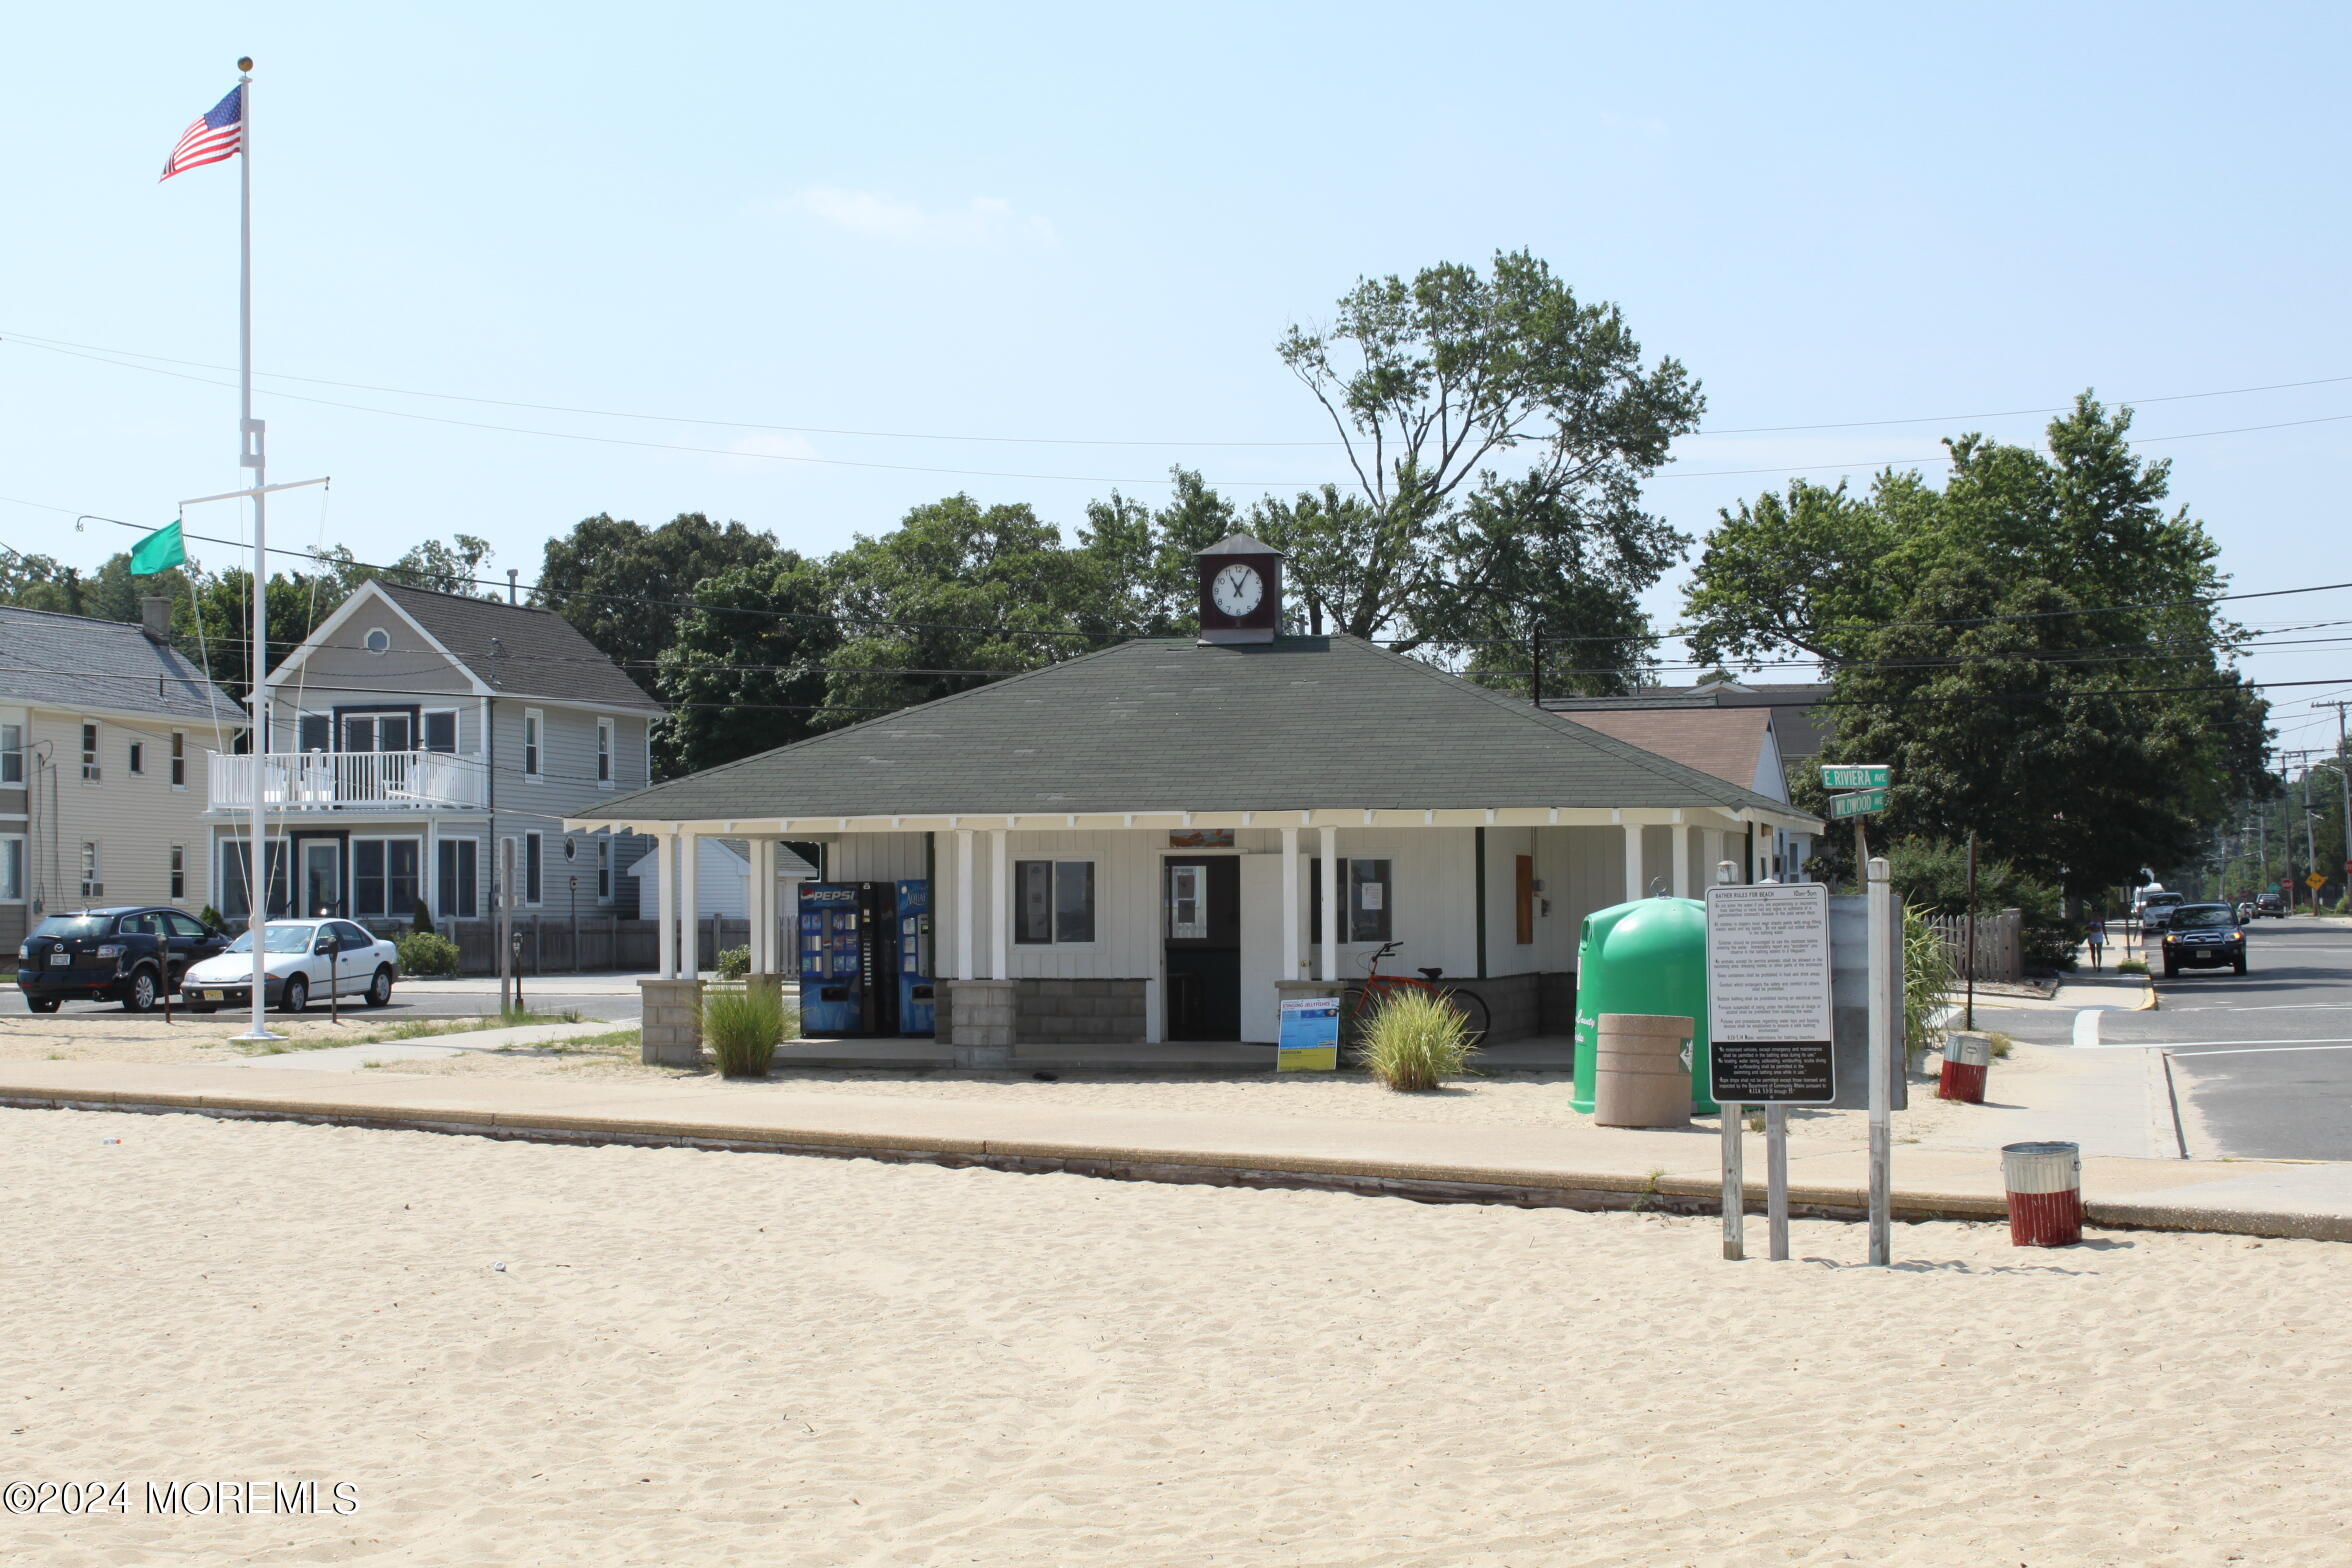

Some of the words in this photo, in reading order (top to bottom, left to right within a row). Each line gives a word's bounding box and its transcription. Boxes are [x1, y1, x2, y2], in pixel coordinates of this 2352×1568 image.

[1824, 770, 1832, 786] E
[1834, 770, 1871, 785] RIVIERA
[1874, 773, 1887, 782] AVE
[1836, 796, 1872, 816] WILDWOOD
[1874, 797, 1883, 805] AVE
[814, 890, 856, 901] PEPSI
